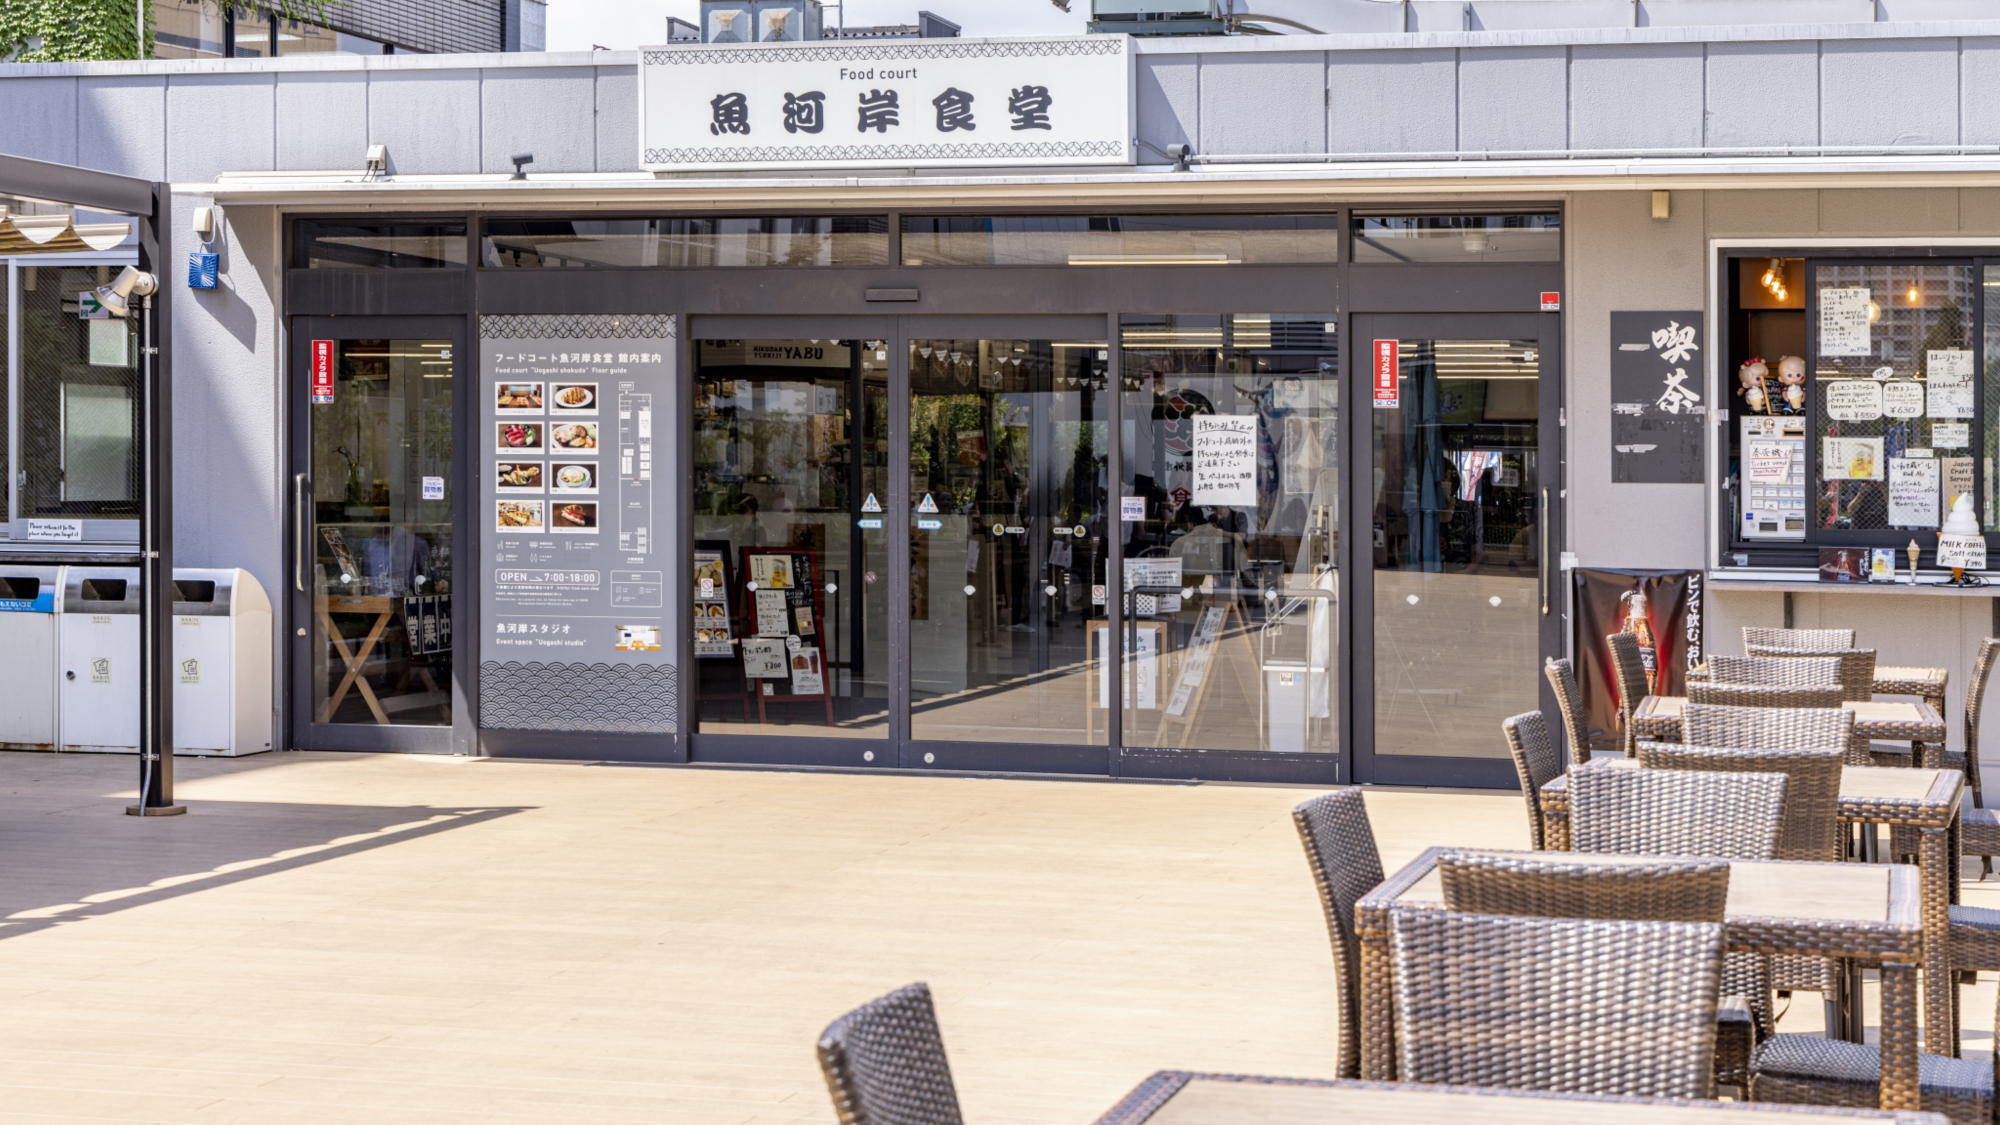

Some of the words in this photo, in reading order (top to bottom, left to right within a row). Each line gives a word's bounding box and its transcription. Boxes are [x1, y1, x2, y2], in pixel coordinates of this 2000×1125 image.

[839, 67, 875, 81] Food
[878, 67, 918, 80] court
[709, 84, 1053, 136] 魚河岸食堂
[495, 353, 614, 364] フードコート魚河岸食堂
[783, 346, 824, 360] YABU
[1651, 320, 1700, 414] 喫茶
[500, 572, 528, 581] OPEN
[544, 572, 595, 582] 7:00-18:00
[496, 623, 571, 634] 魚河岸スタジオ
